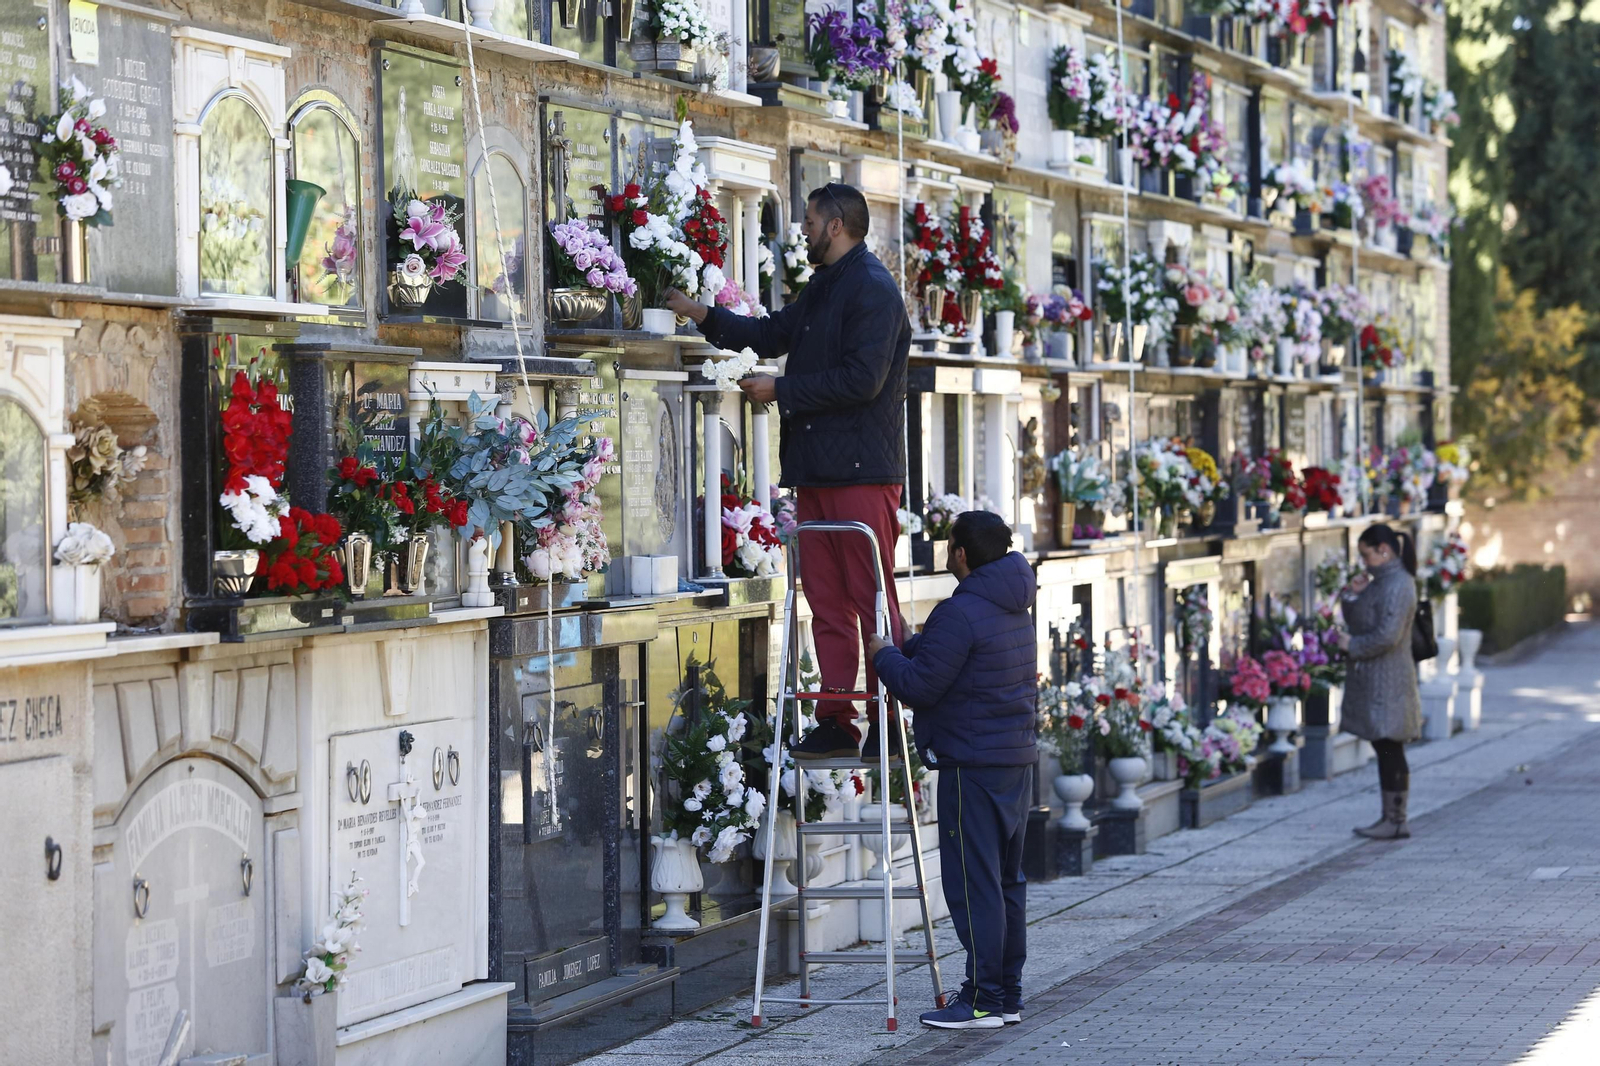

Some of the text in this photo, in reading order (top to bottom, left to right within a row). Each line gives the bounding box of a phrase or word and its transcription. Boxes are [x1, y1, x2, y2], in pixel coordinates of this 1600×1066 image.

[72, 17, 96, 36] VENCIDA
[124, 58, 147, 80] MIGUEL
[102, 78, 161, 106] RODRIGUEZ GARCIA
[432, 84, 446, 100] JOSEFA
[423, 102, 455, 121] PEREA ALCALDE
[430, 141, 451, 158] SEBASTIAN
[420, 158, 460, 178] GONZALEZ SALGUERO
[376, 392, 402, 410] MARIA
[442, 794, 462, 809] FERNANDEZ
[128, 783, 249, 860] FAMILIA ALONSO MORCILLO
[343, 817, 356, 830] MARIA
[358, 812, 378, 827] BENAVIDES
[378, 808, 397, 822] REVELLES
[129, 948, 148, 969] ALONSO
[538, 953, 600, 989] FAMILIA JIMENEZ LOPEZ
[146, 987, 165, 1008] FELIPE
